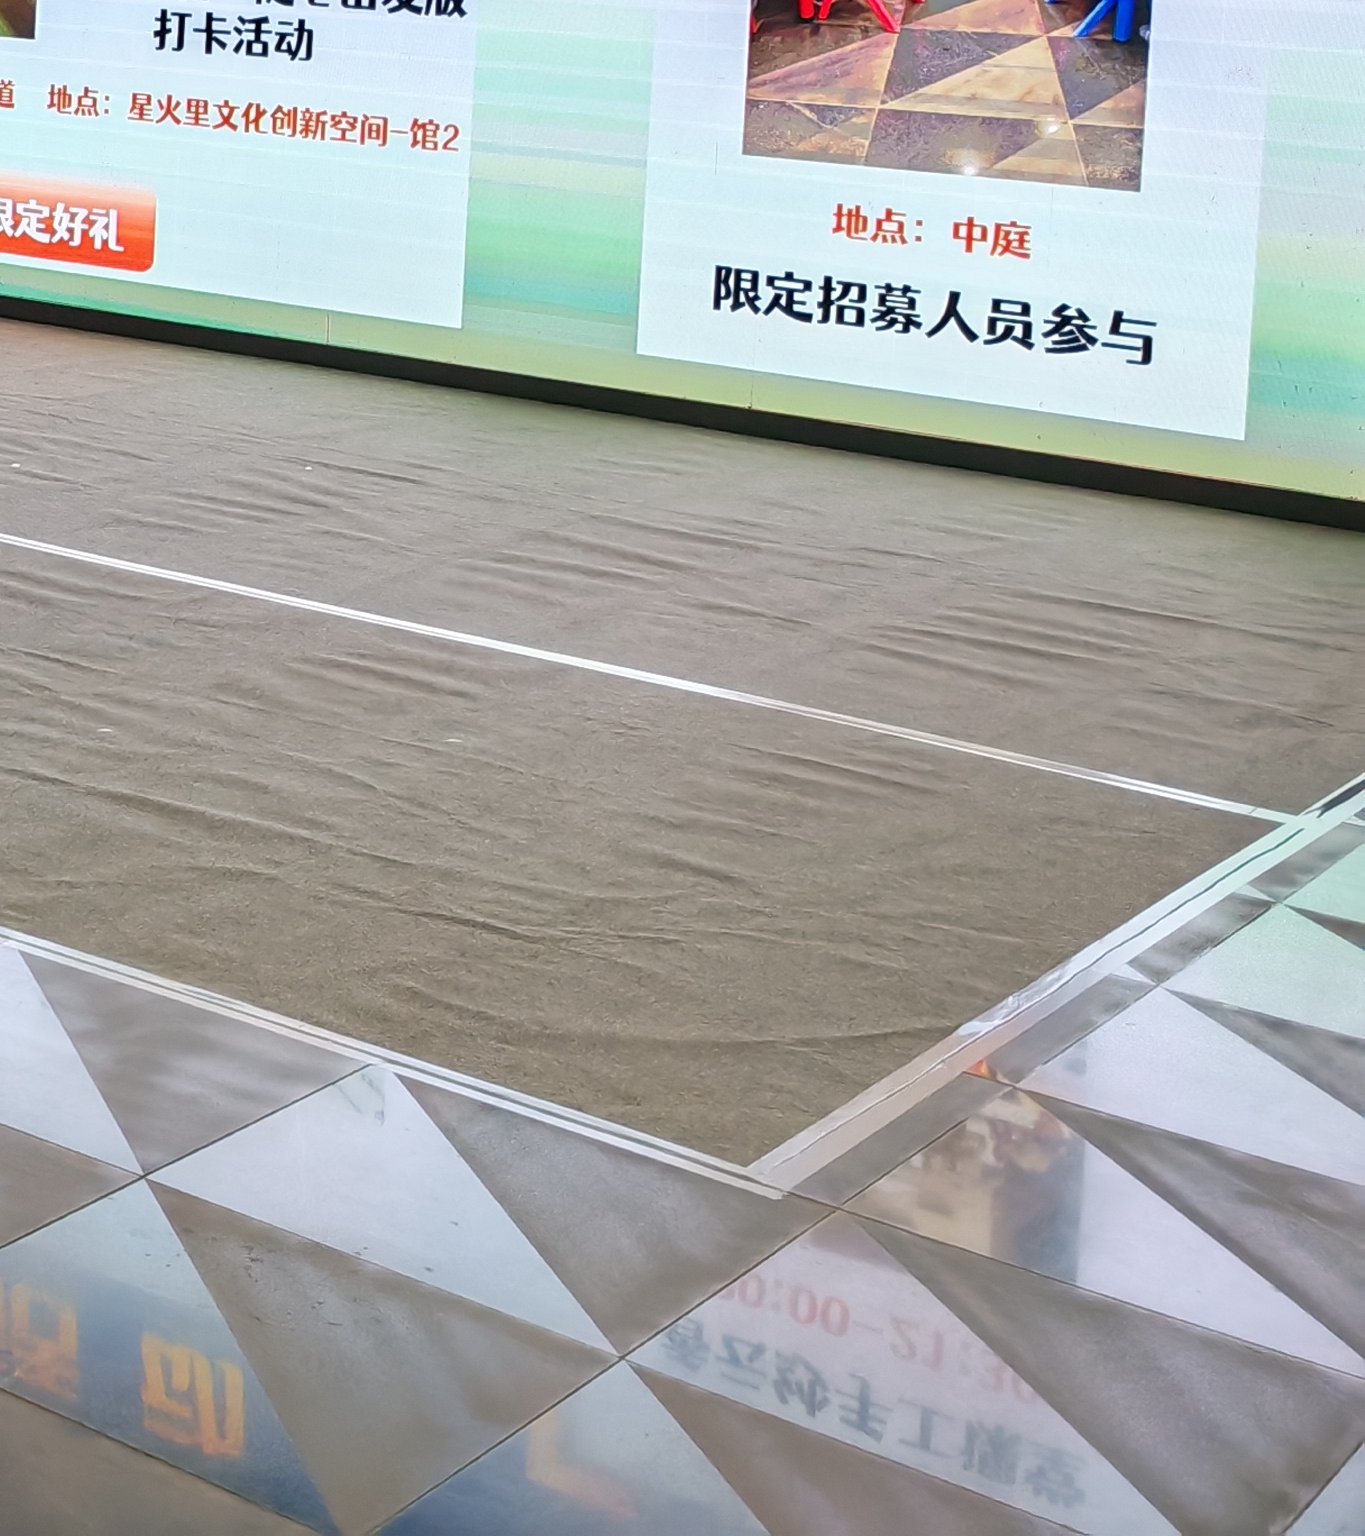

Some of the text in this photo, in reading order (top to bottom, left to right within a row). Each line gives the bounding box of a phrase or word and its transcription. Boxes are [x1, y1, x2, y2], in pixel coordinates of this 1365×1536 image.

[153, 10, 314, 61] 打卡活动
[831, 203, 1033, 261] 地点：中庭
[712, 263, 1158, 366] 限定招募人员参与
